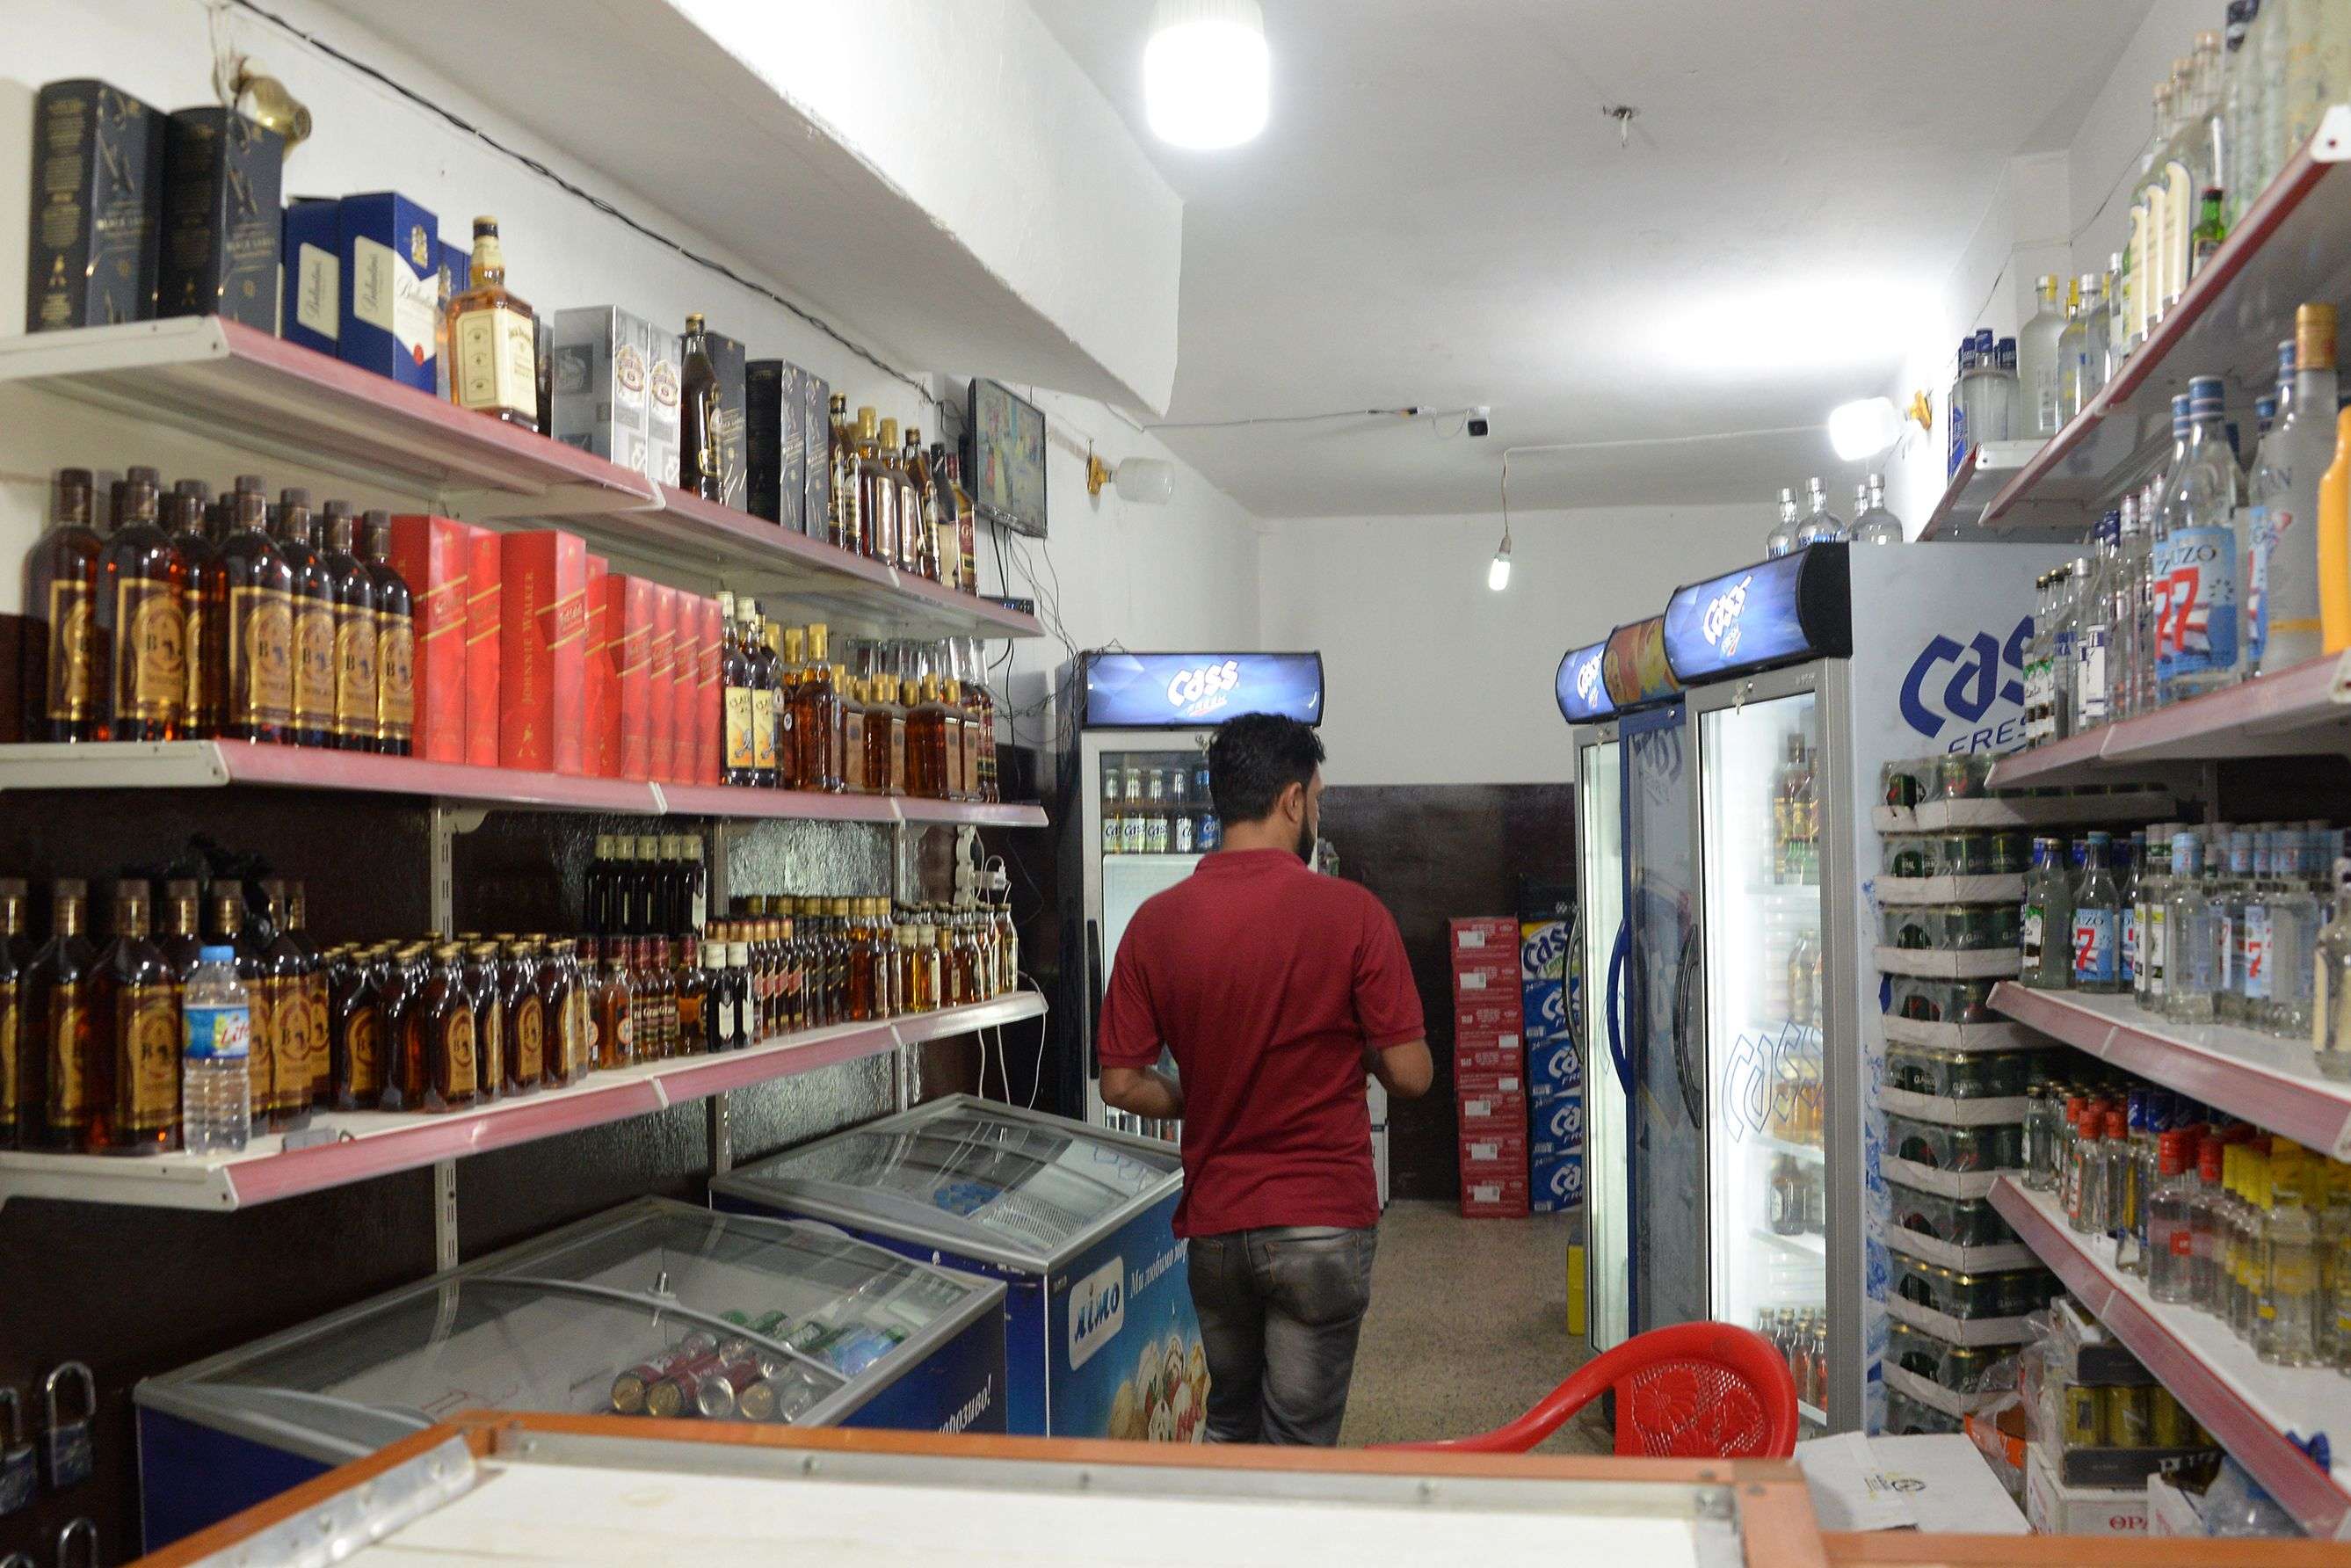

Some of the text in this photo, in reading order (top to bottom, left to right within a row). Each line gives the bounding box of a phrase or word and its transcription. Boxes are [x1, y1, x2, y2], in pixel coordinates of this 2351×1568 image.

[2171, 567, 2200, 652] 7
[1899, 615, 2035, 738] Cas
[1948, 718, 2026, 754] FRE
[2076, 928, 2095, 971] 7
[1549, 1048, 1581, 1078] Ca
[1550, 1105, 1581, 1137] Ca
[1550, 1163, 1581, 1196] Ca
[934, 1372, 992, 1434] орозиво!
